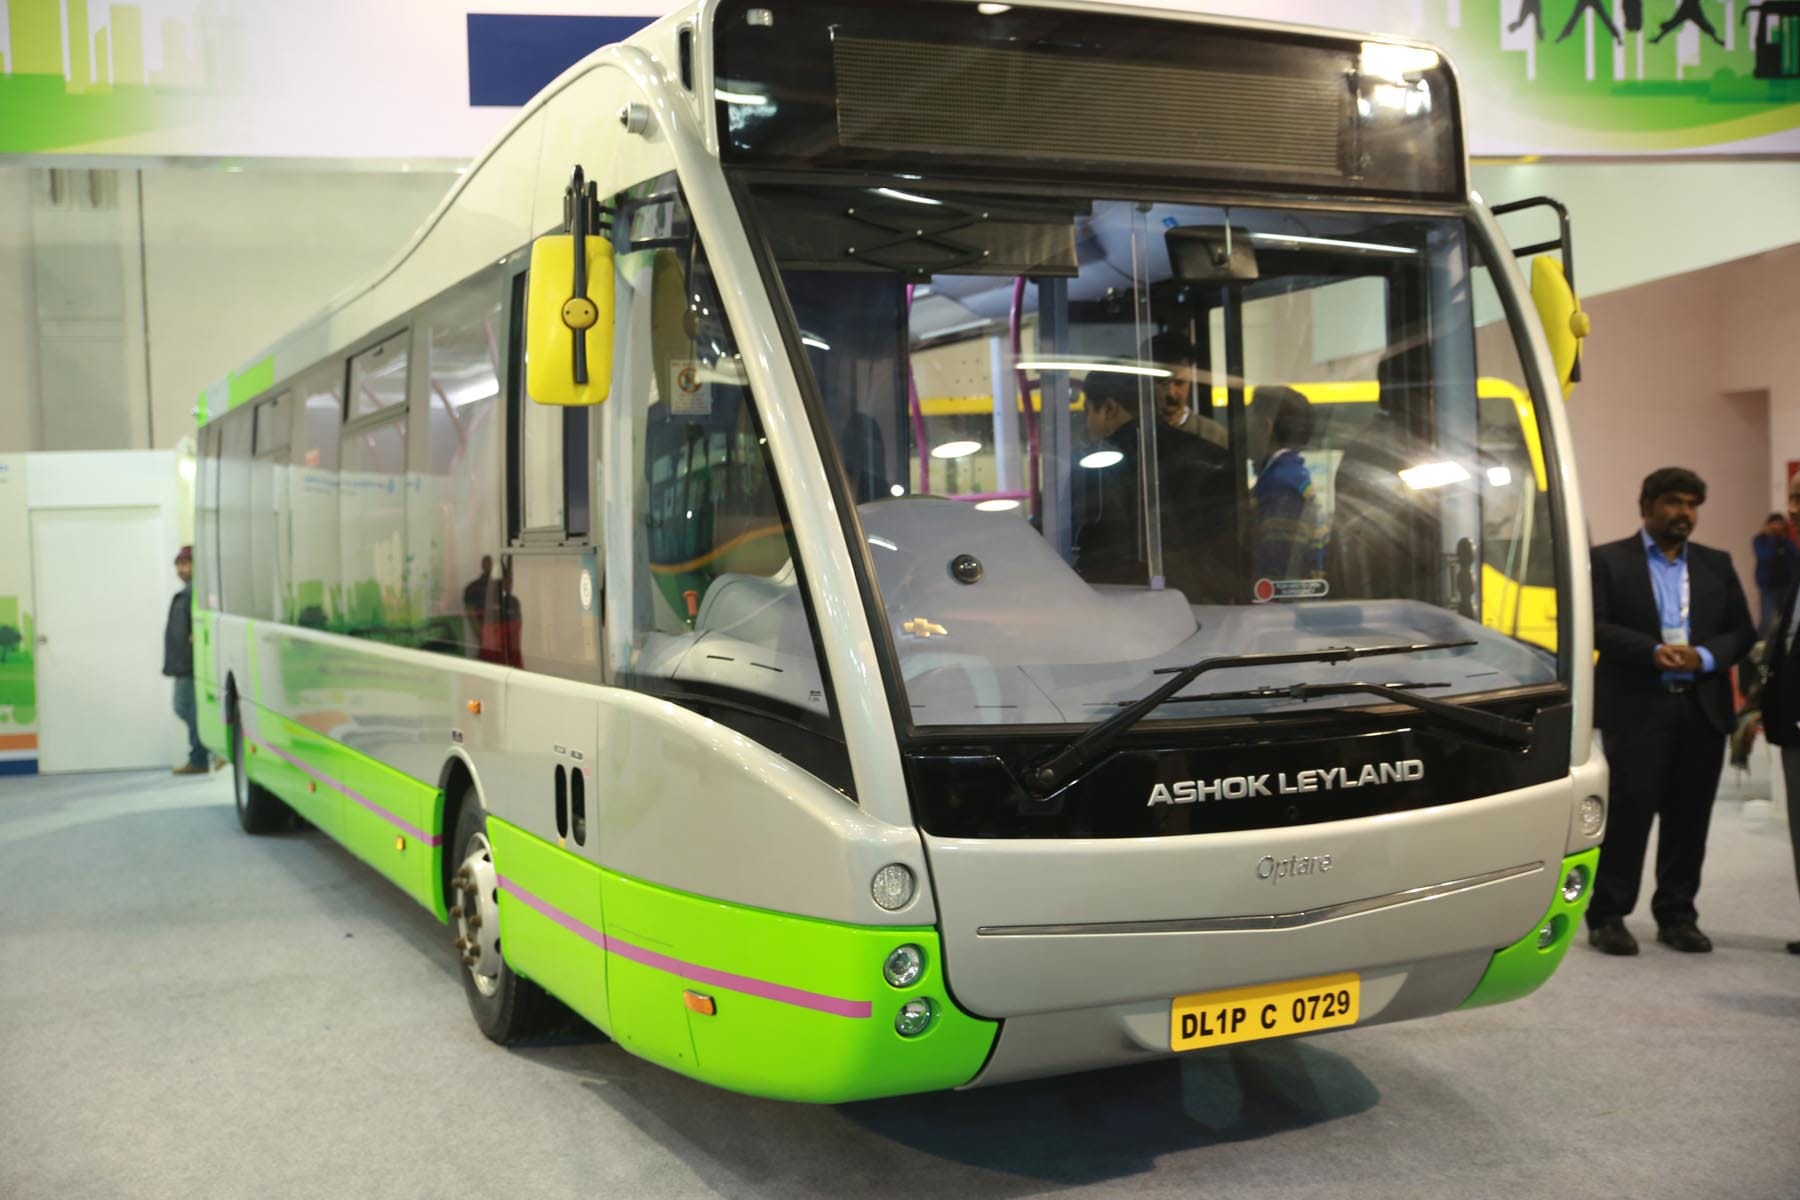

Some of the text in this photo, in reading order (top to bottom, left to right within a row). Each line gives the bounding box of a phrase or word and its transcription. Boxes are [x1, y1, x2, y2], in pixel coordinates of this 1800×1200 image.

[1147, 759, 1424, 807] ASHOK LEYLAND
[1256, 853, 1333, 885] Optare
[1182, 990, 1350, 1039] DL1P C 0729
